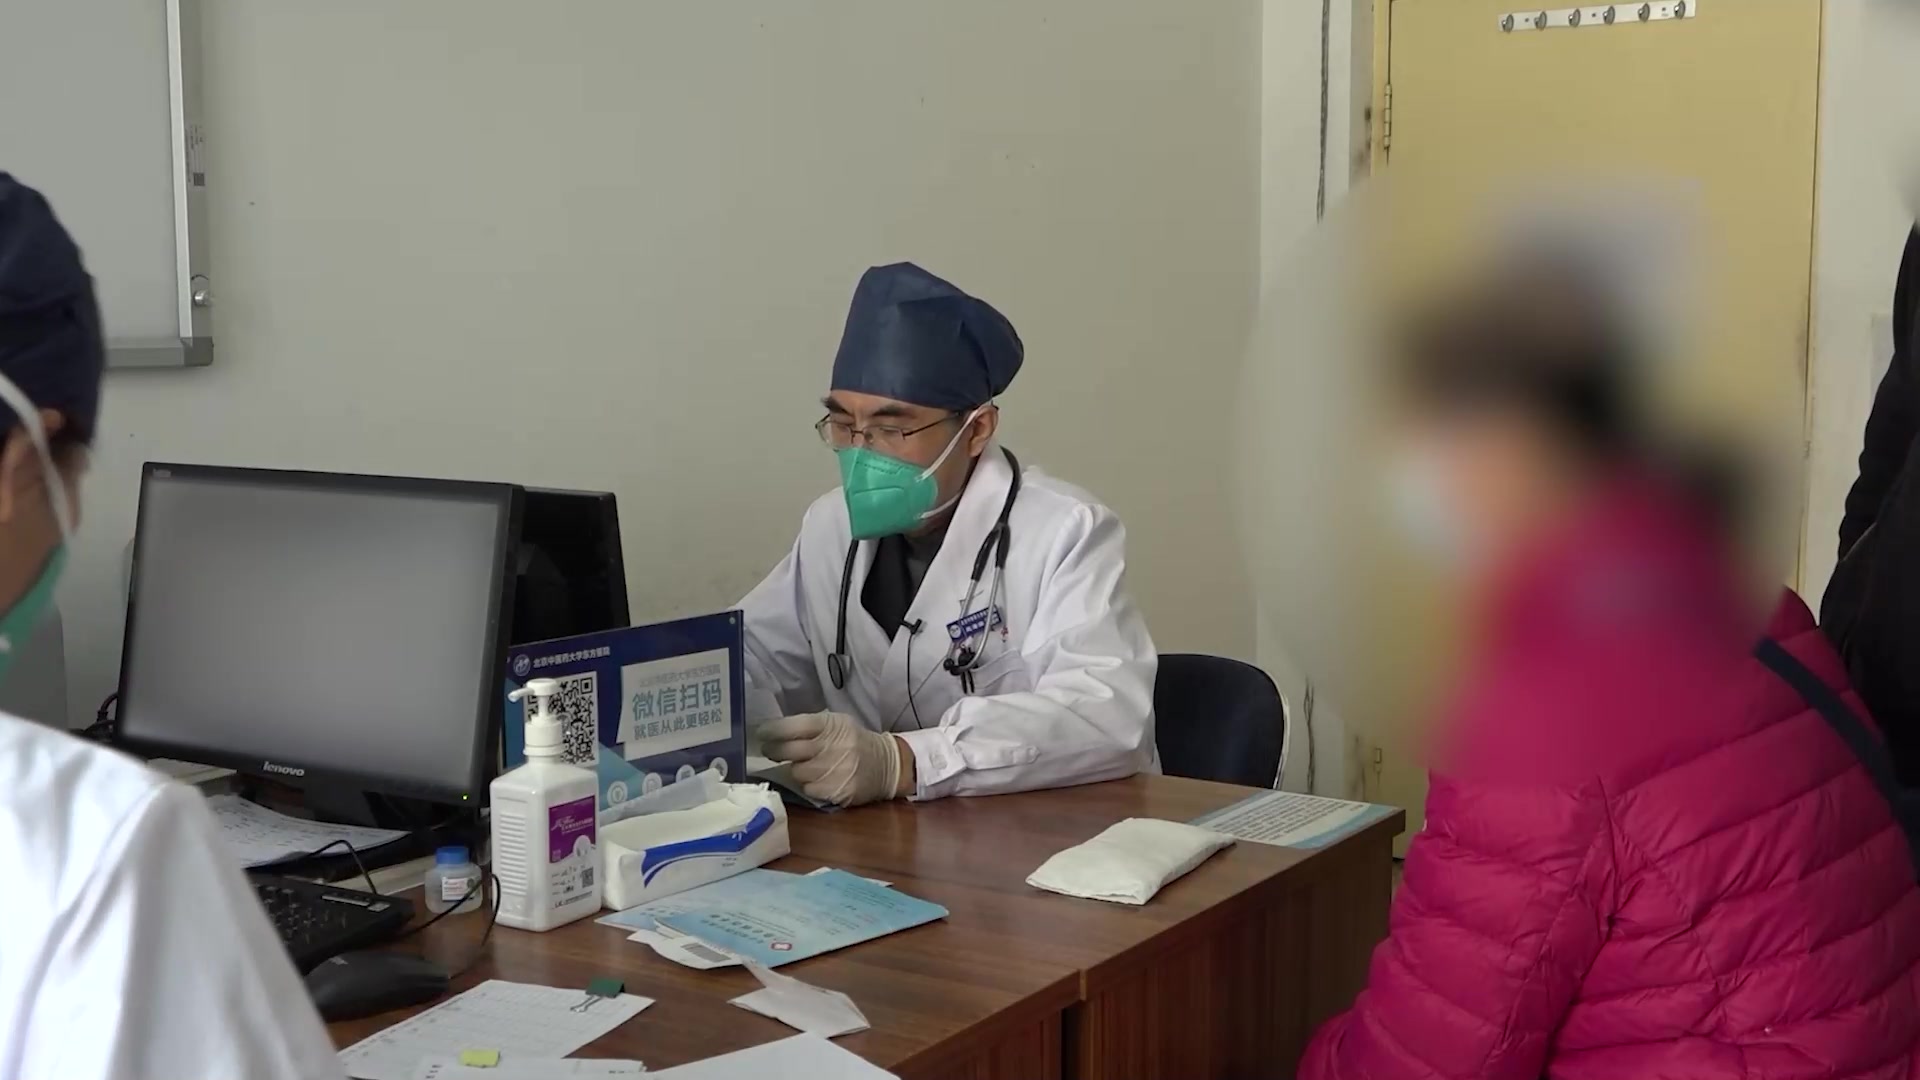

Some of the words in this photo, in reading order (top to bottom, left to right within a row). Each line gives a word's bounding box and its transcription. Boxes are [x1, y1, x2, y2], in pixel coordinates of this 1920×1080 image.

[632, 678, 722, 721] 微信扫码
[634, 708, 722, 740] 就医从此更轻松
[263, 761, 305, 777] lenovo
